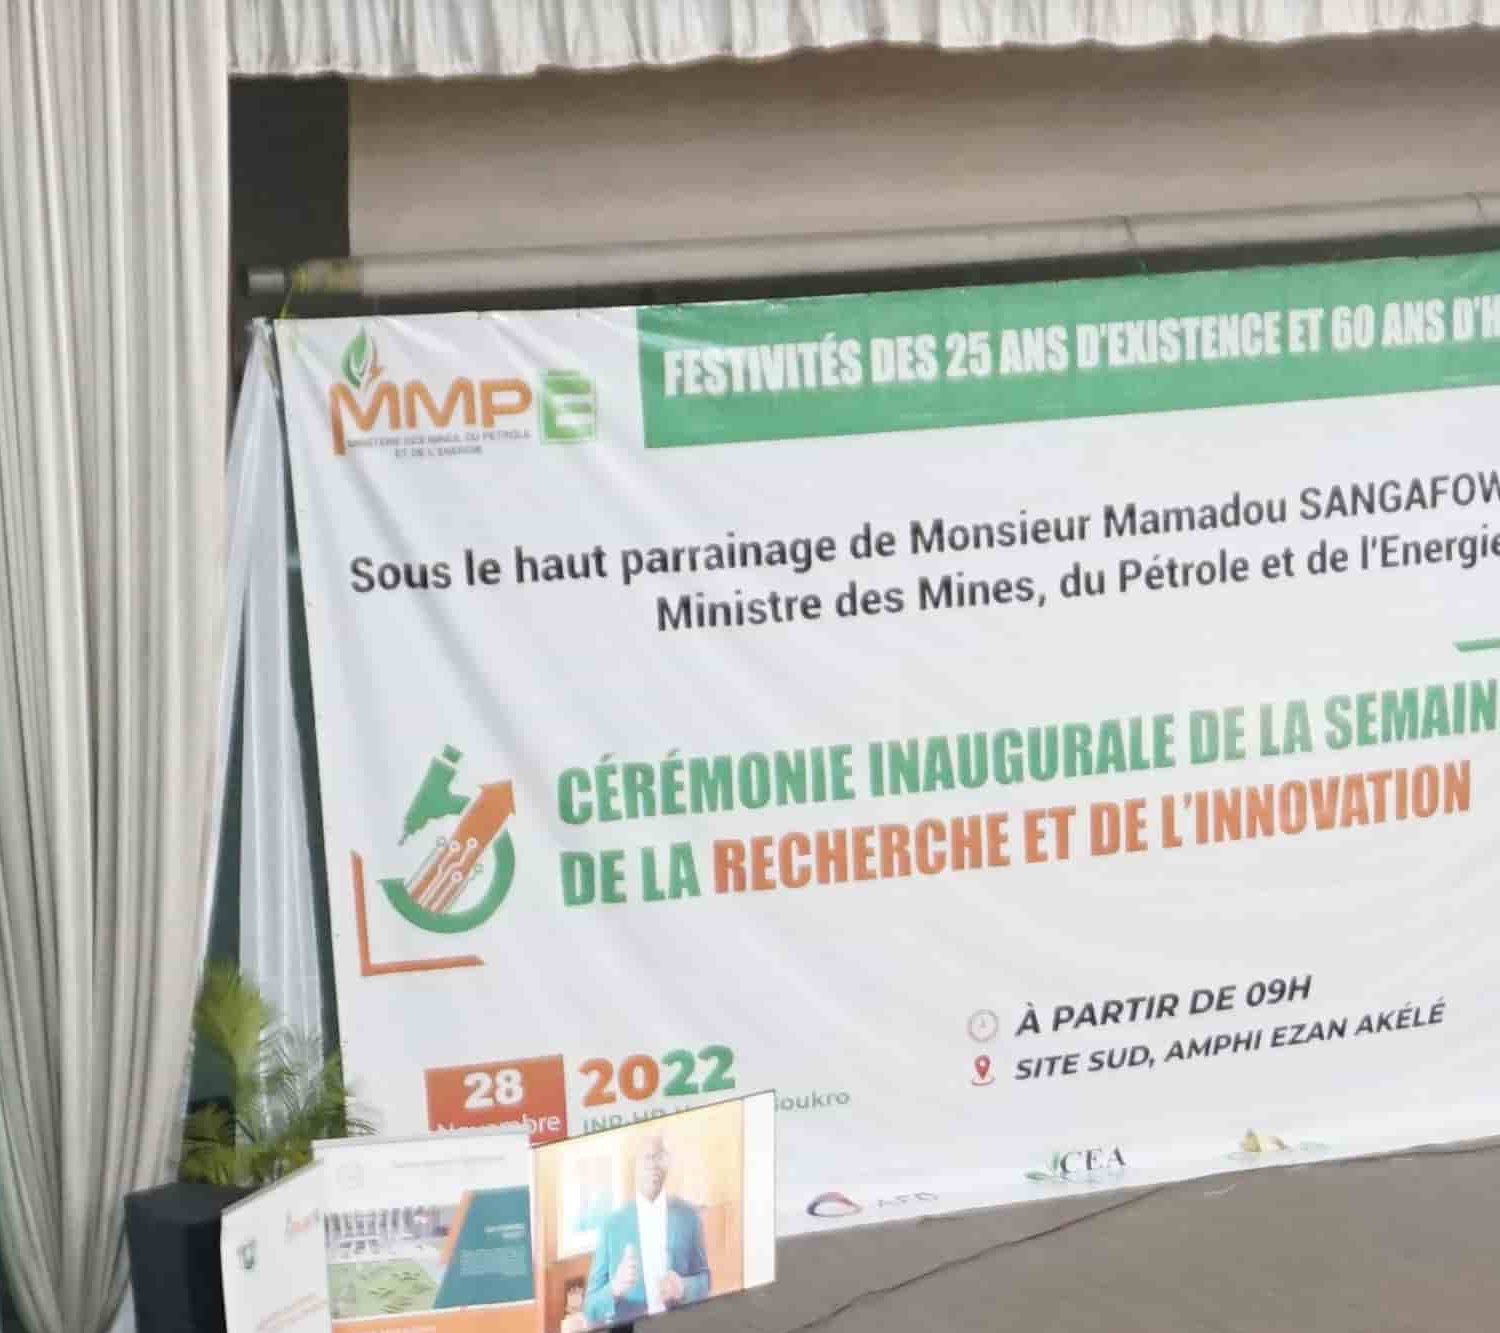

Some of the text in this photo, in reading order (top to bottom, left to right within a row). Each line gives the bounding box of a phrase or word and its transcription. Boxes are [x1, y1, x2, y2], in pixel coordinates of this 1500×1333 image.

[664, 331, 862, 397] FESTIVITÉS
[872, 331, 937, 381] DES
[946, 328, 992, 378] 25
[1000, 325, 1070, 374] ANS
[1077, 306, 1280, 368] D'EXISTENCE
[1288, 305, 1325, 352] ET
[1333, 302, 1374, 349] 60
[1382, 298, 1445, 346] ANS
[350, 556, 452, 593] Sous
[464, 550, 501, 586] le
[515, 544, 607, 583] haut
[622, 533, 837, 585] parrainage
[850, 524, 896, 560] de
[909, 509, 1091, 554] Monsieur
[1104, 490, 1288, 539] Mamadou
[656, 588, 822, 632] Ministre
[834, 580, 905, 618] des
[918, 571, 1047, 612] Mines,
[1059, 563, 1105, 599] du
[1117, 549, 1249, 595] Pétrole
[1261, 545, 1294, 578] et
[1306, 537, 1349, 574] de
[558, 744, 855, 825] CÉRÉMONIE
[868, 713, 1174, 796] INAUGURALE
[1190, 705, 1247, 766] DE
[1260, 700, 1315, 757] LA
[561, 759, 1471, 908] DE LA RECHERCHE ET DE L'INNOVATION
[1014, 999, 1447, 1082] SITE SUD, AMPHI EZAN AKÉLÉ
[1016, 974, 1313, 1036] À PARTIR DE 09H
[463, 1069, 524, 1110] 28
[578, 1044, 735, 1107] 2022
